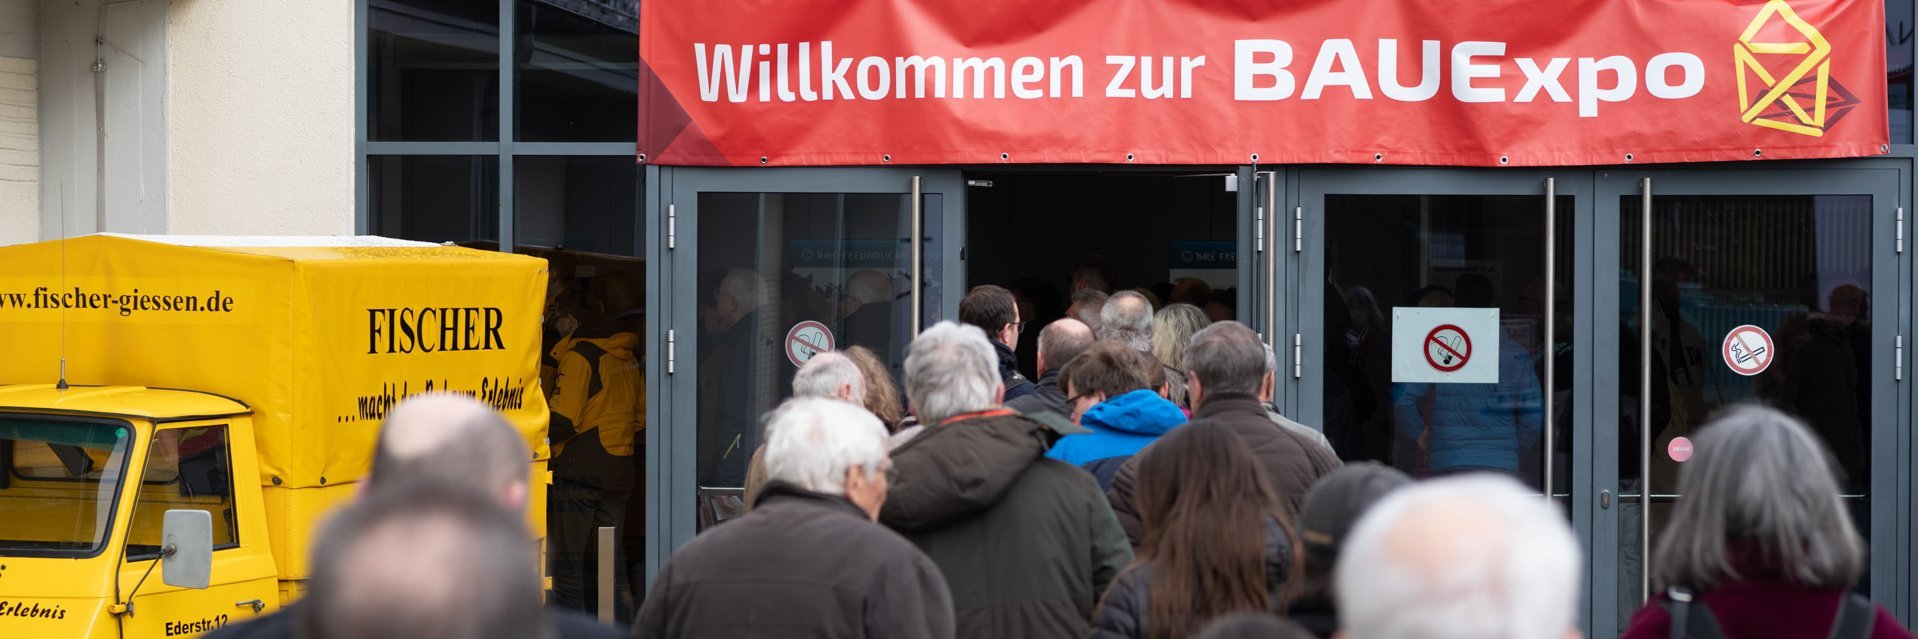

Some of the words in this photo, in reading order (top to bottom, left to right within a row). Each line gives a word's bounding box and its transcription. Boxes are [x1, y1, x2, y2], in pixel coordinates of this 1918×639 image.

[694, 40, 1084, 103] Willkommen
[1105, 54, 1206, 99] zur
[1234, 38, 1706, 118] BAUExpo
[366, 306, 506, 355] FISCHER
[0, 601, 66, 619] Erlebnis
